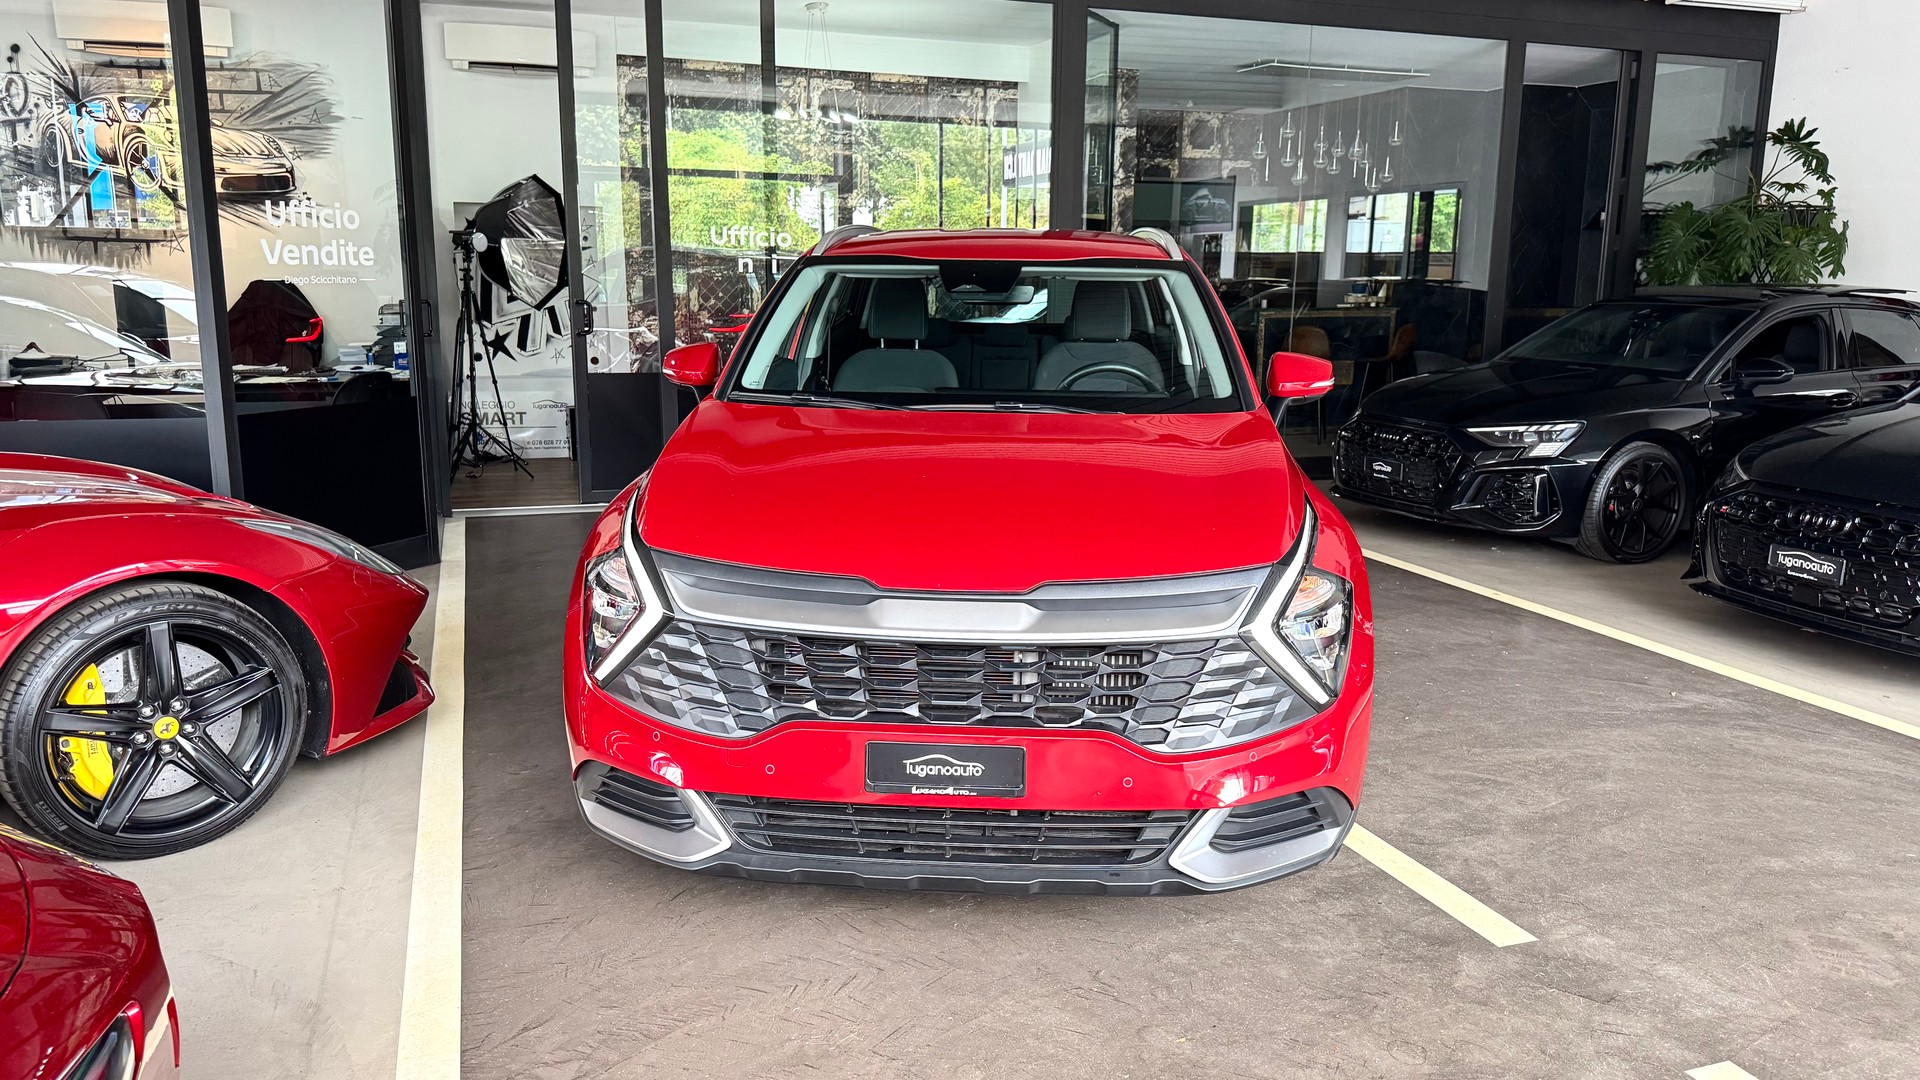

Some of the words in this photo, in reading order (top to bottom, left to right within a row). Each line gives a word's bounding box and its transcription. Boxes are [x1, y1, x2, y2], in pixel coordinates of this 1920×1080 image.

[265, 199, 360, 229] Ufficio
[710, 224, 792, 247] Ufficio
[260, 238, 375, 266] Vendite
[284, 275, 309, 285] Diego
[310, 275, 358, 284] Scicchitano
